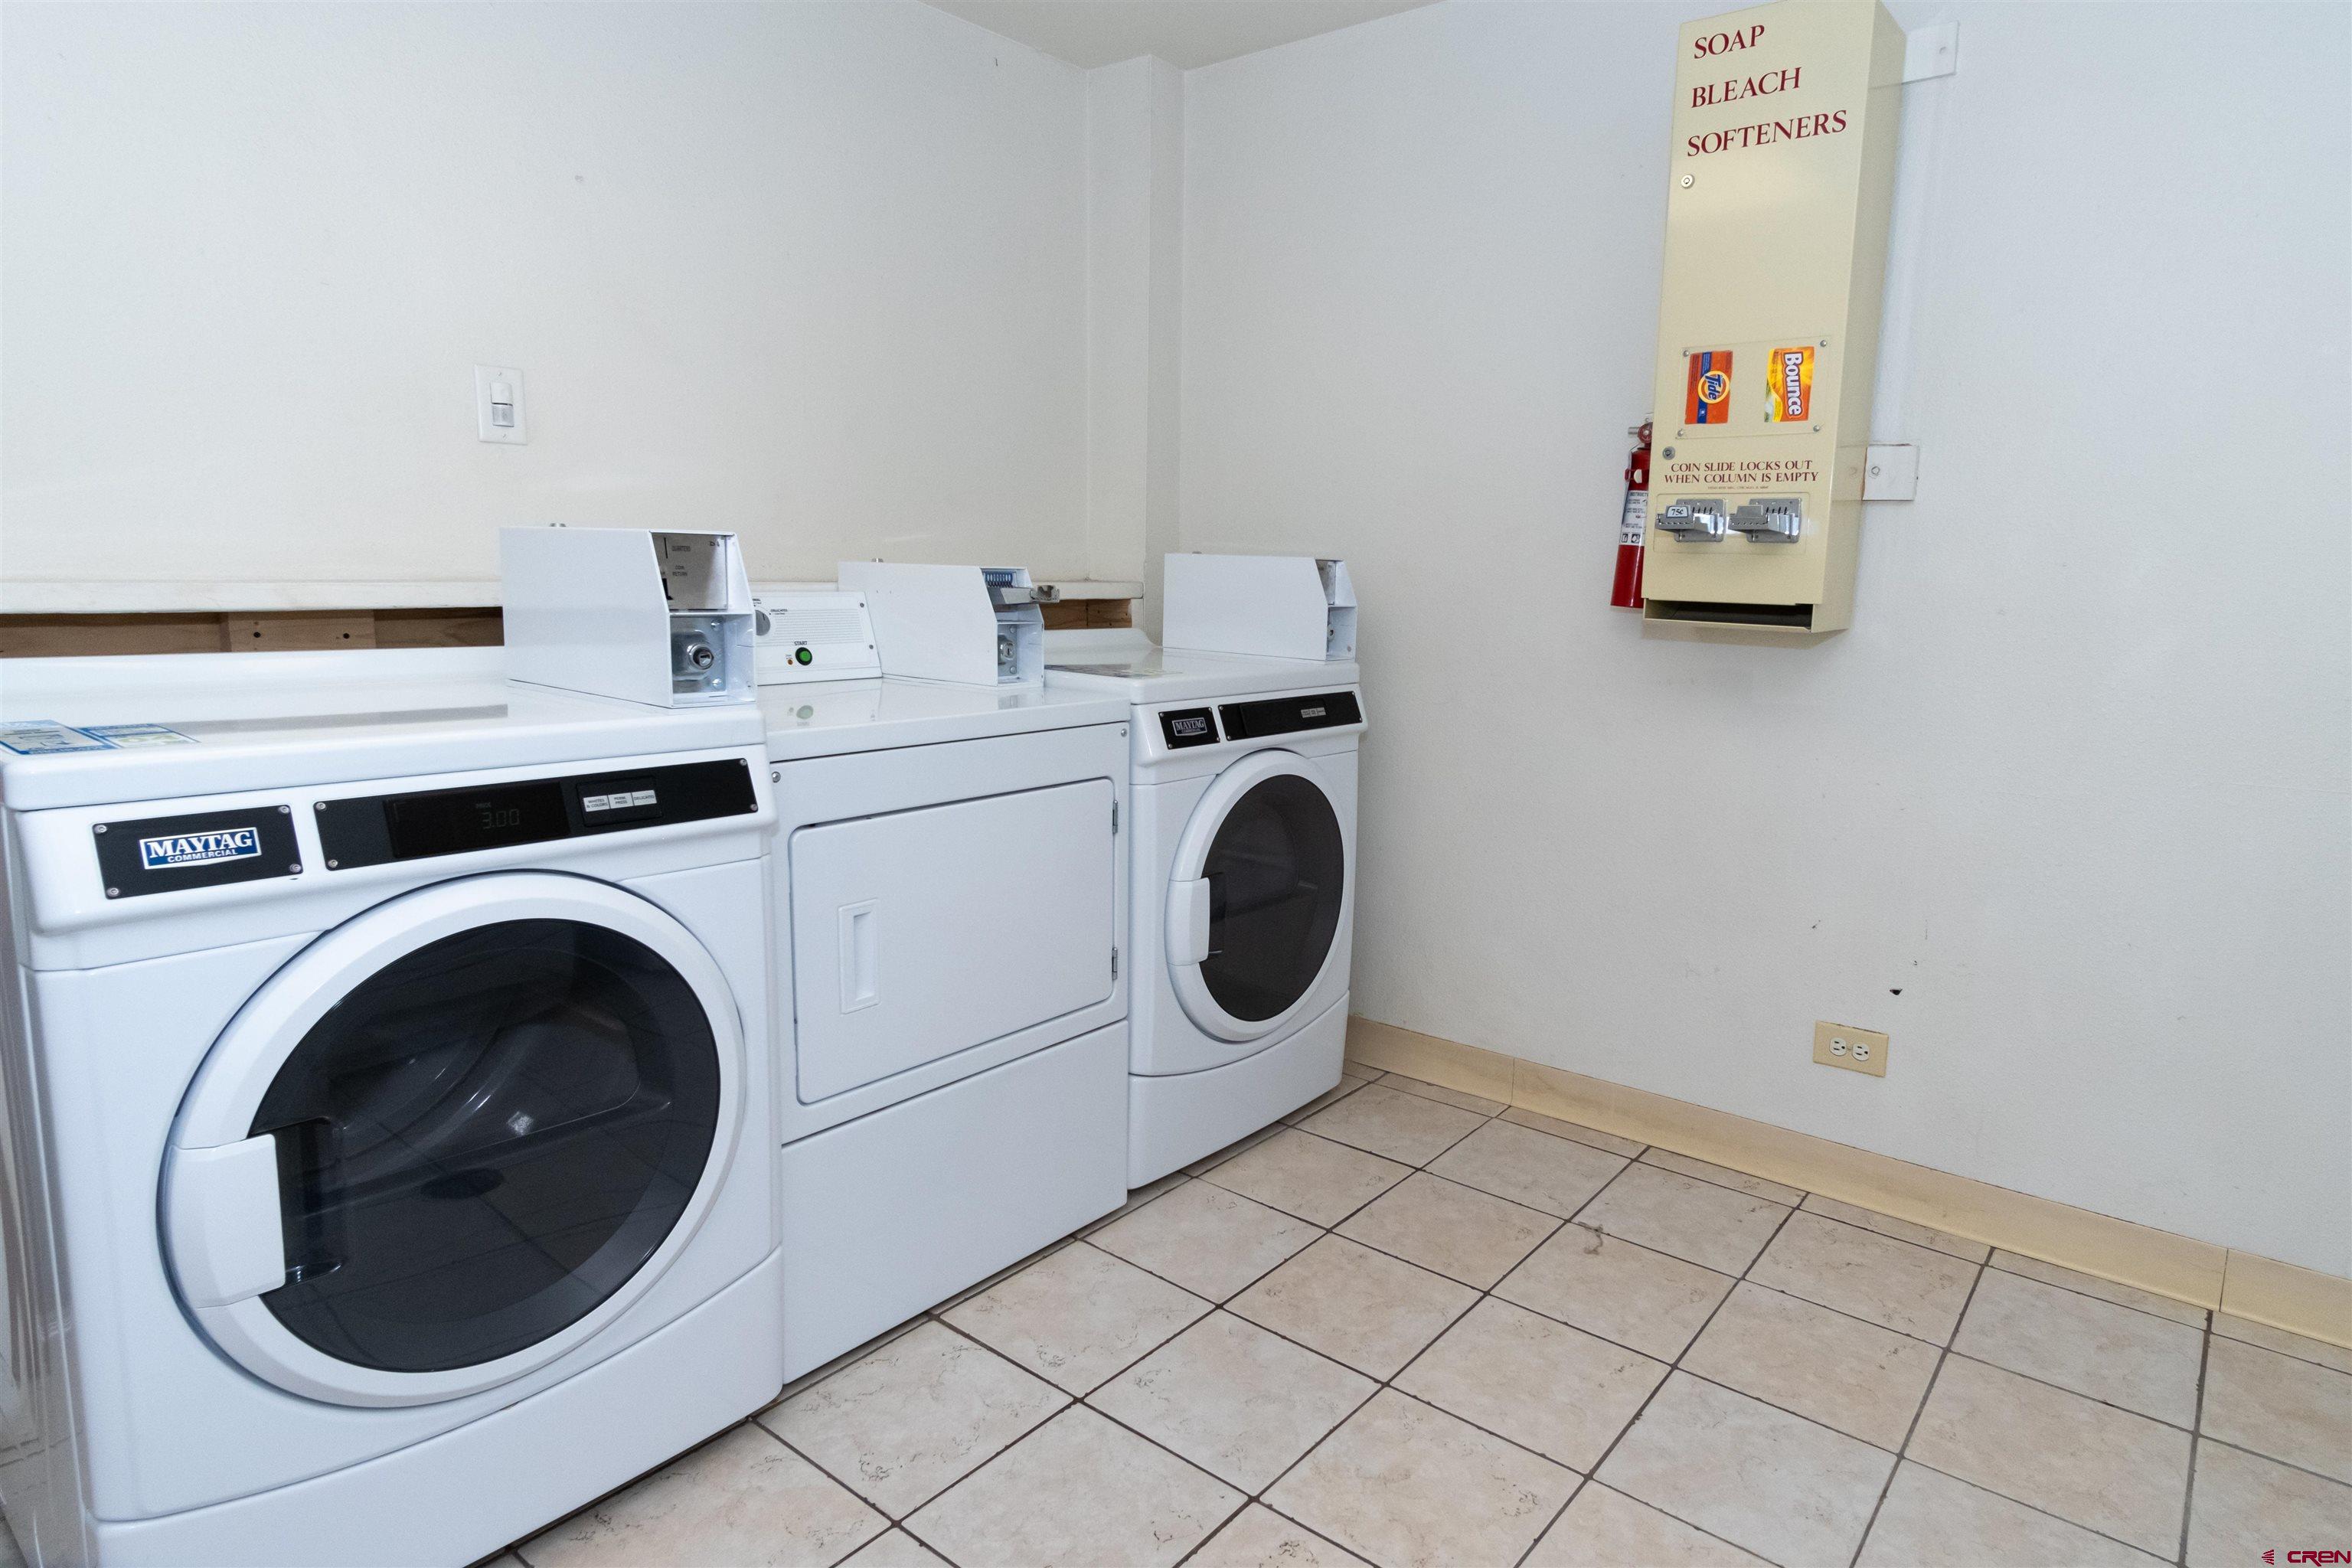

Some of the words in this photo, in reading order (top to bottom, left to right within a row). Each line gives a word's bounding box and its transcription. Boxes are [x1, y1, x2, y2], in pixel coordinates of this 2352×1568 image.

[1694, 24, 1766, 59] SOAP
[1690, 67, 1802, 109] BLEACH
[1687, 109, 1847, 157] SOFTENERS
[1704, 374, 1722, 400] Tide
[1784, 352, 1803, 416] Bounce
[1664, 474, 1700, 484] WHEN
[1704, 473, 1757, 483] COLUMN
[1762, 472, 1772, 482] IS
[1775, 472, 1819, 482] EMPTY
[1671, 462, 1701, 472] COIN
[1704, 462, 1736, 472] SLIDE
[1740, 461, 1781, 471] LOCKS
[1785, 460, 1813, 470] OUT
[1174, 720, 1204, 731] MAYTAG
[482, 808, 520, 829] 3.00
[146, 831, 253, 858] MAYTAG
[167, 848, 239, 863] COMMERCIAL
